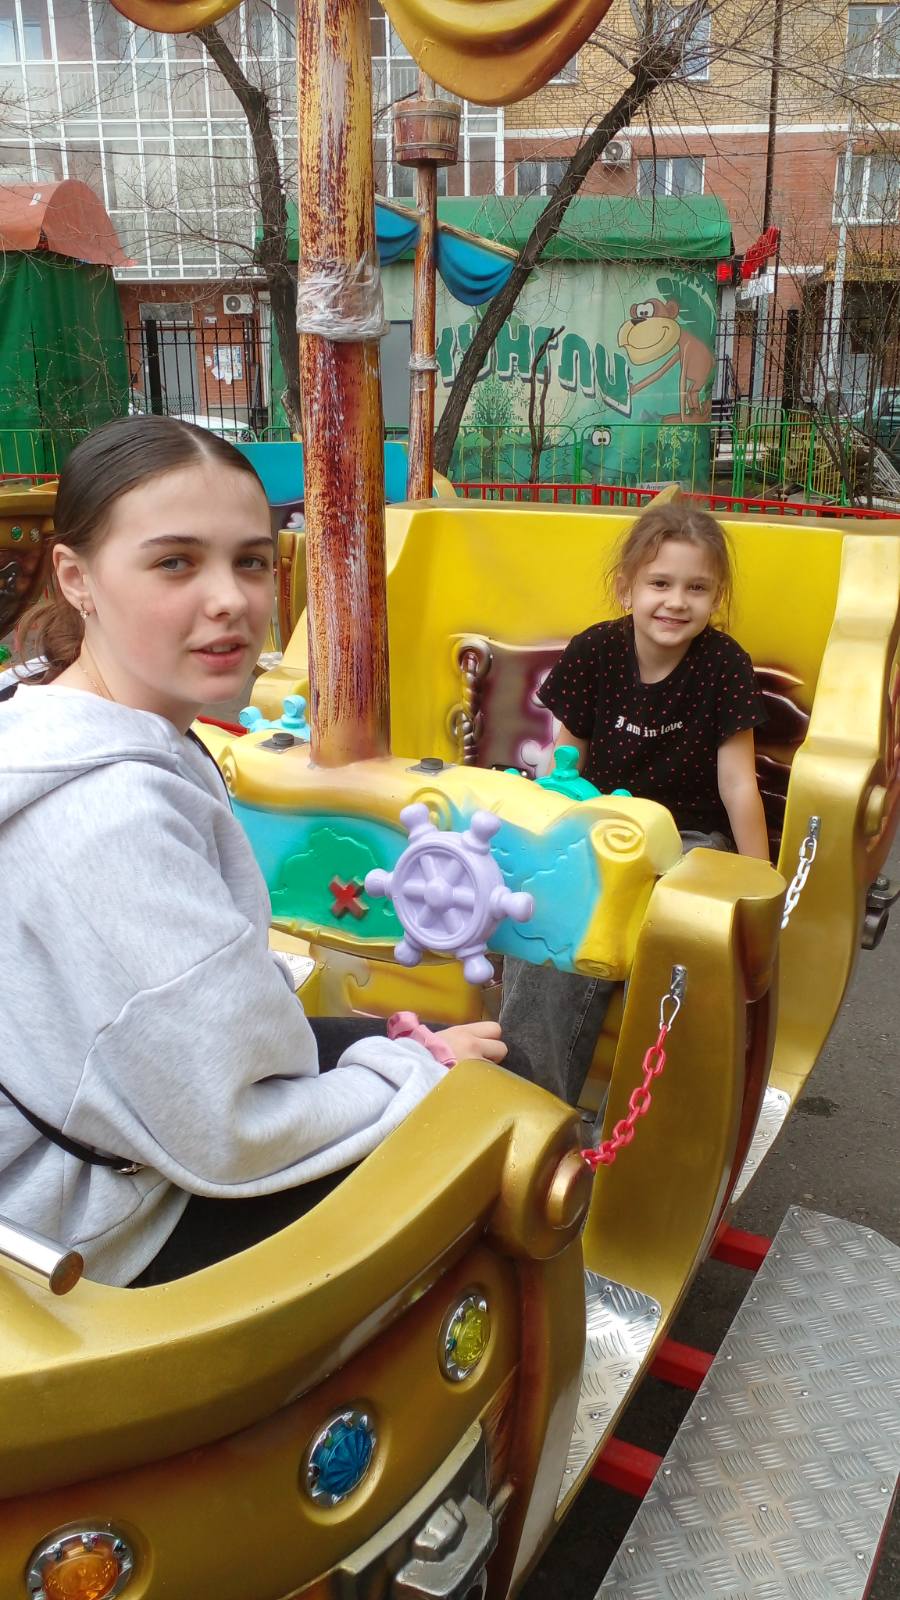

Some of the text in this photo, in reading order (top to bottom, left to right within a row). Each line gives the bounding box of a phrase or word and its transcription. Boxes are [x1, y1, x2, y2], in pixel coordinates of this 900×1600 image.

[614, 715, 684, 738] I am in love
